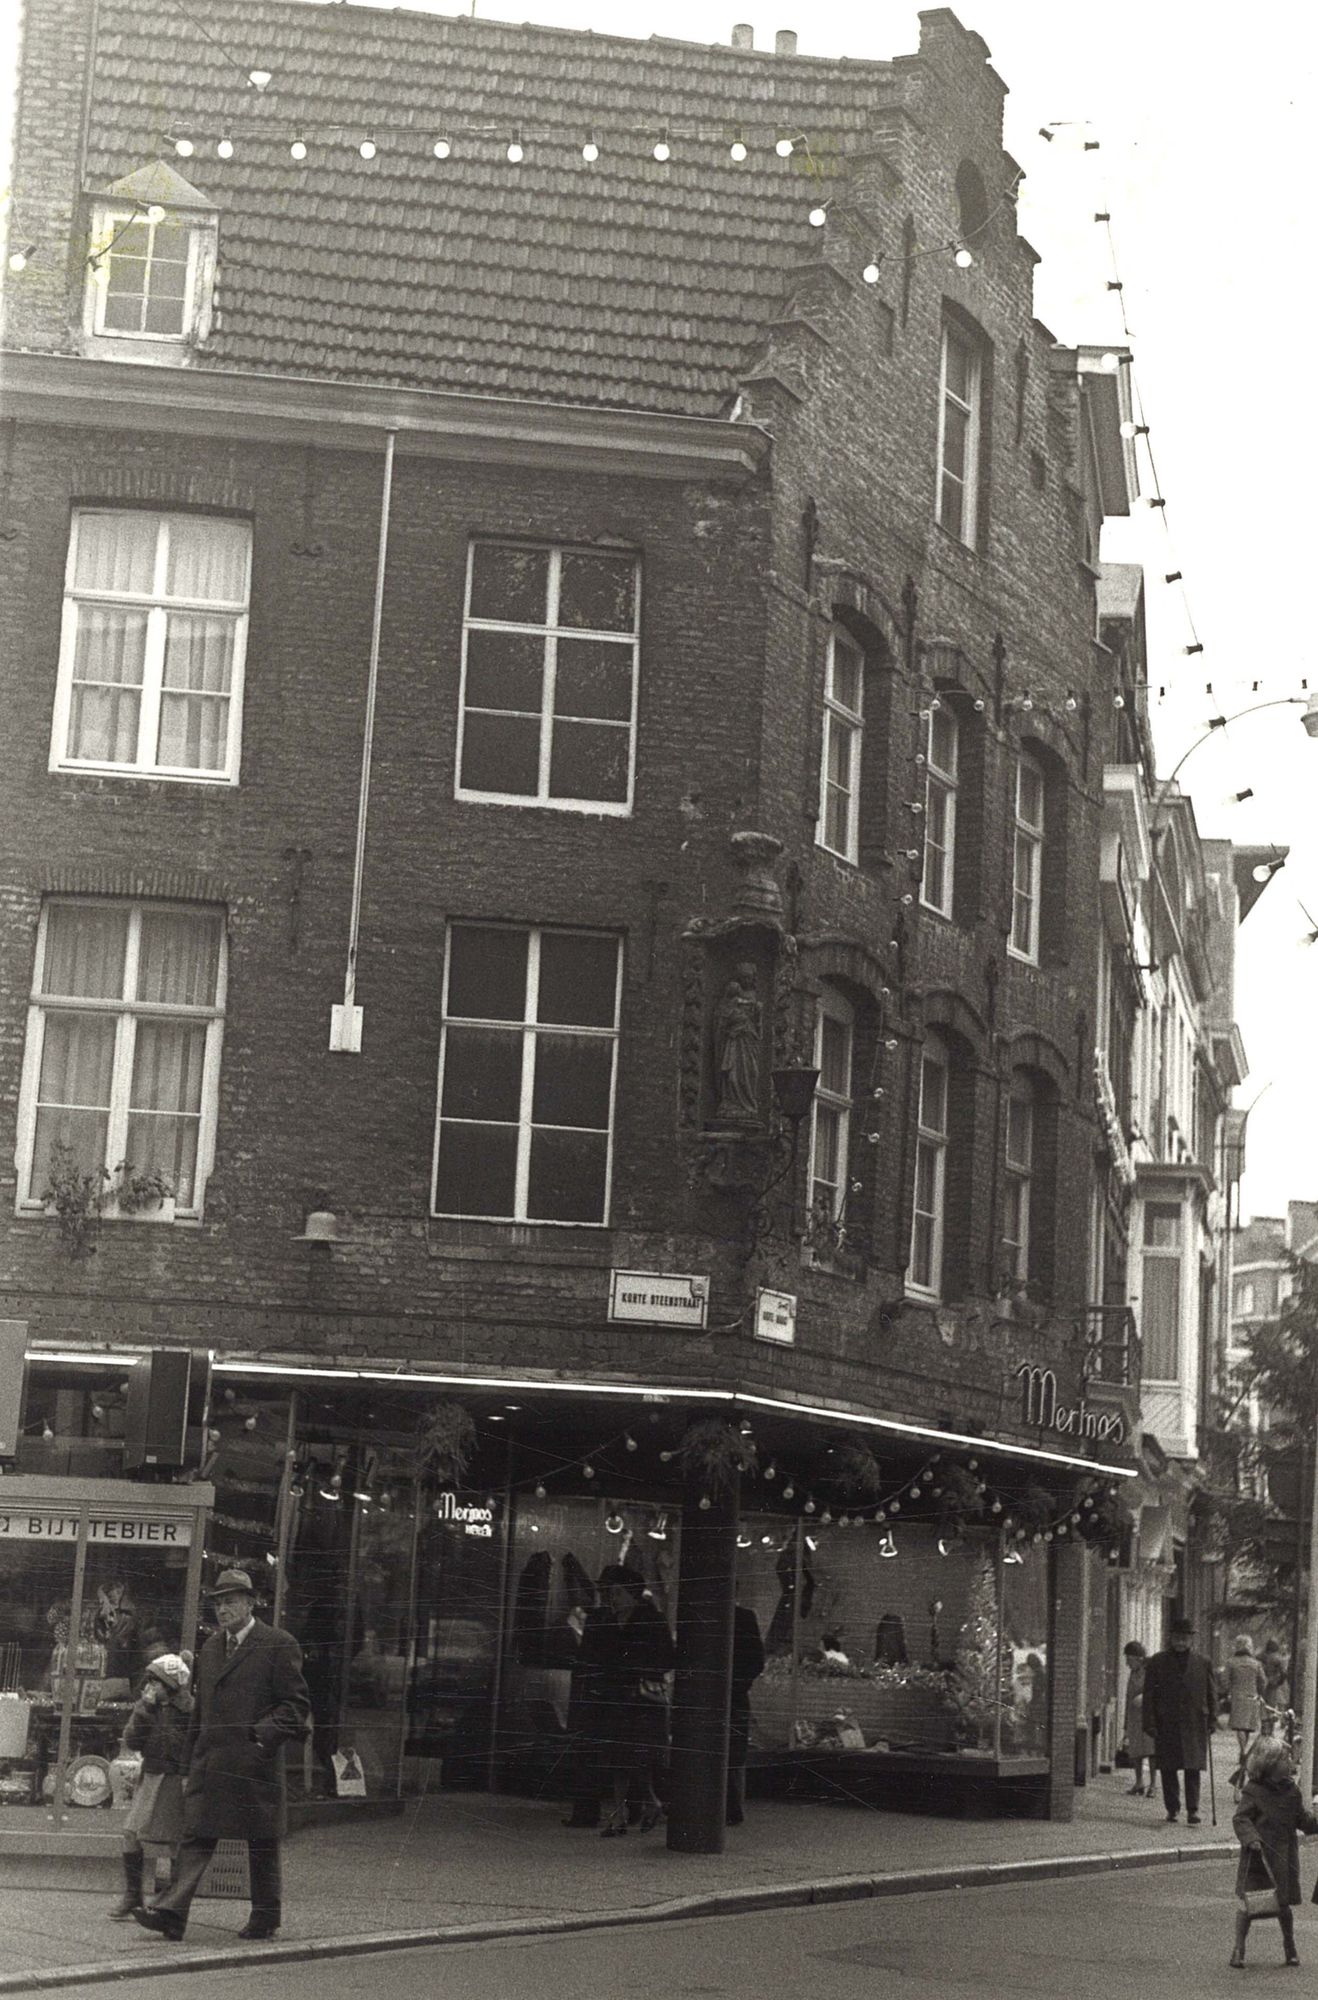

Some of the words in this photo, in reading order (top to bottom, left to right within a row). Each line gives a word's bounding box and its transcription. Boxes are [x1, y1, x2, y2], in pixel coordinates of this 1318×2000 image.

[622, 1292, 646, 1305] KORTE
[650, 1294, 700, 1308] STEENSTRAAT
[1018, 1364, 1124, 1444] Merinos
[28, 1517, 177, 1541] BIJTTEBIER
